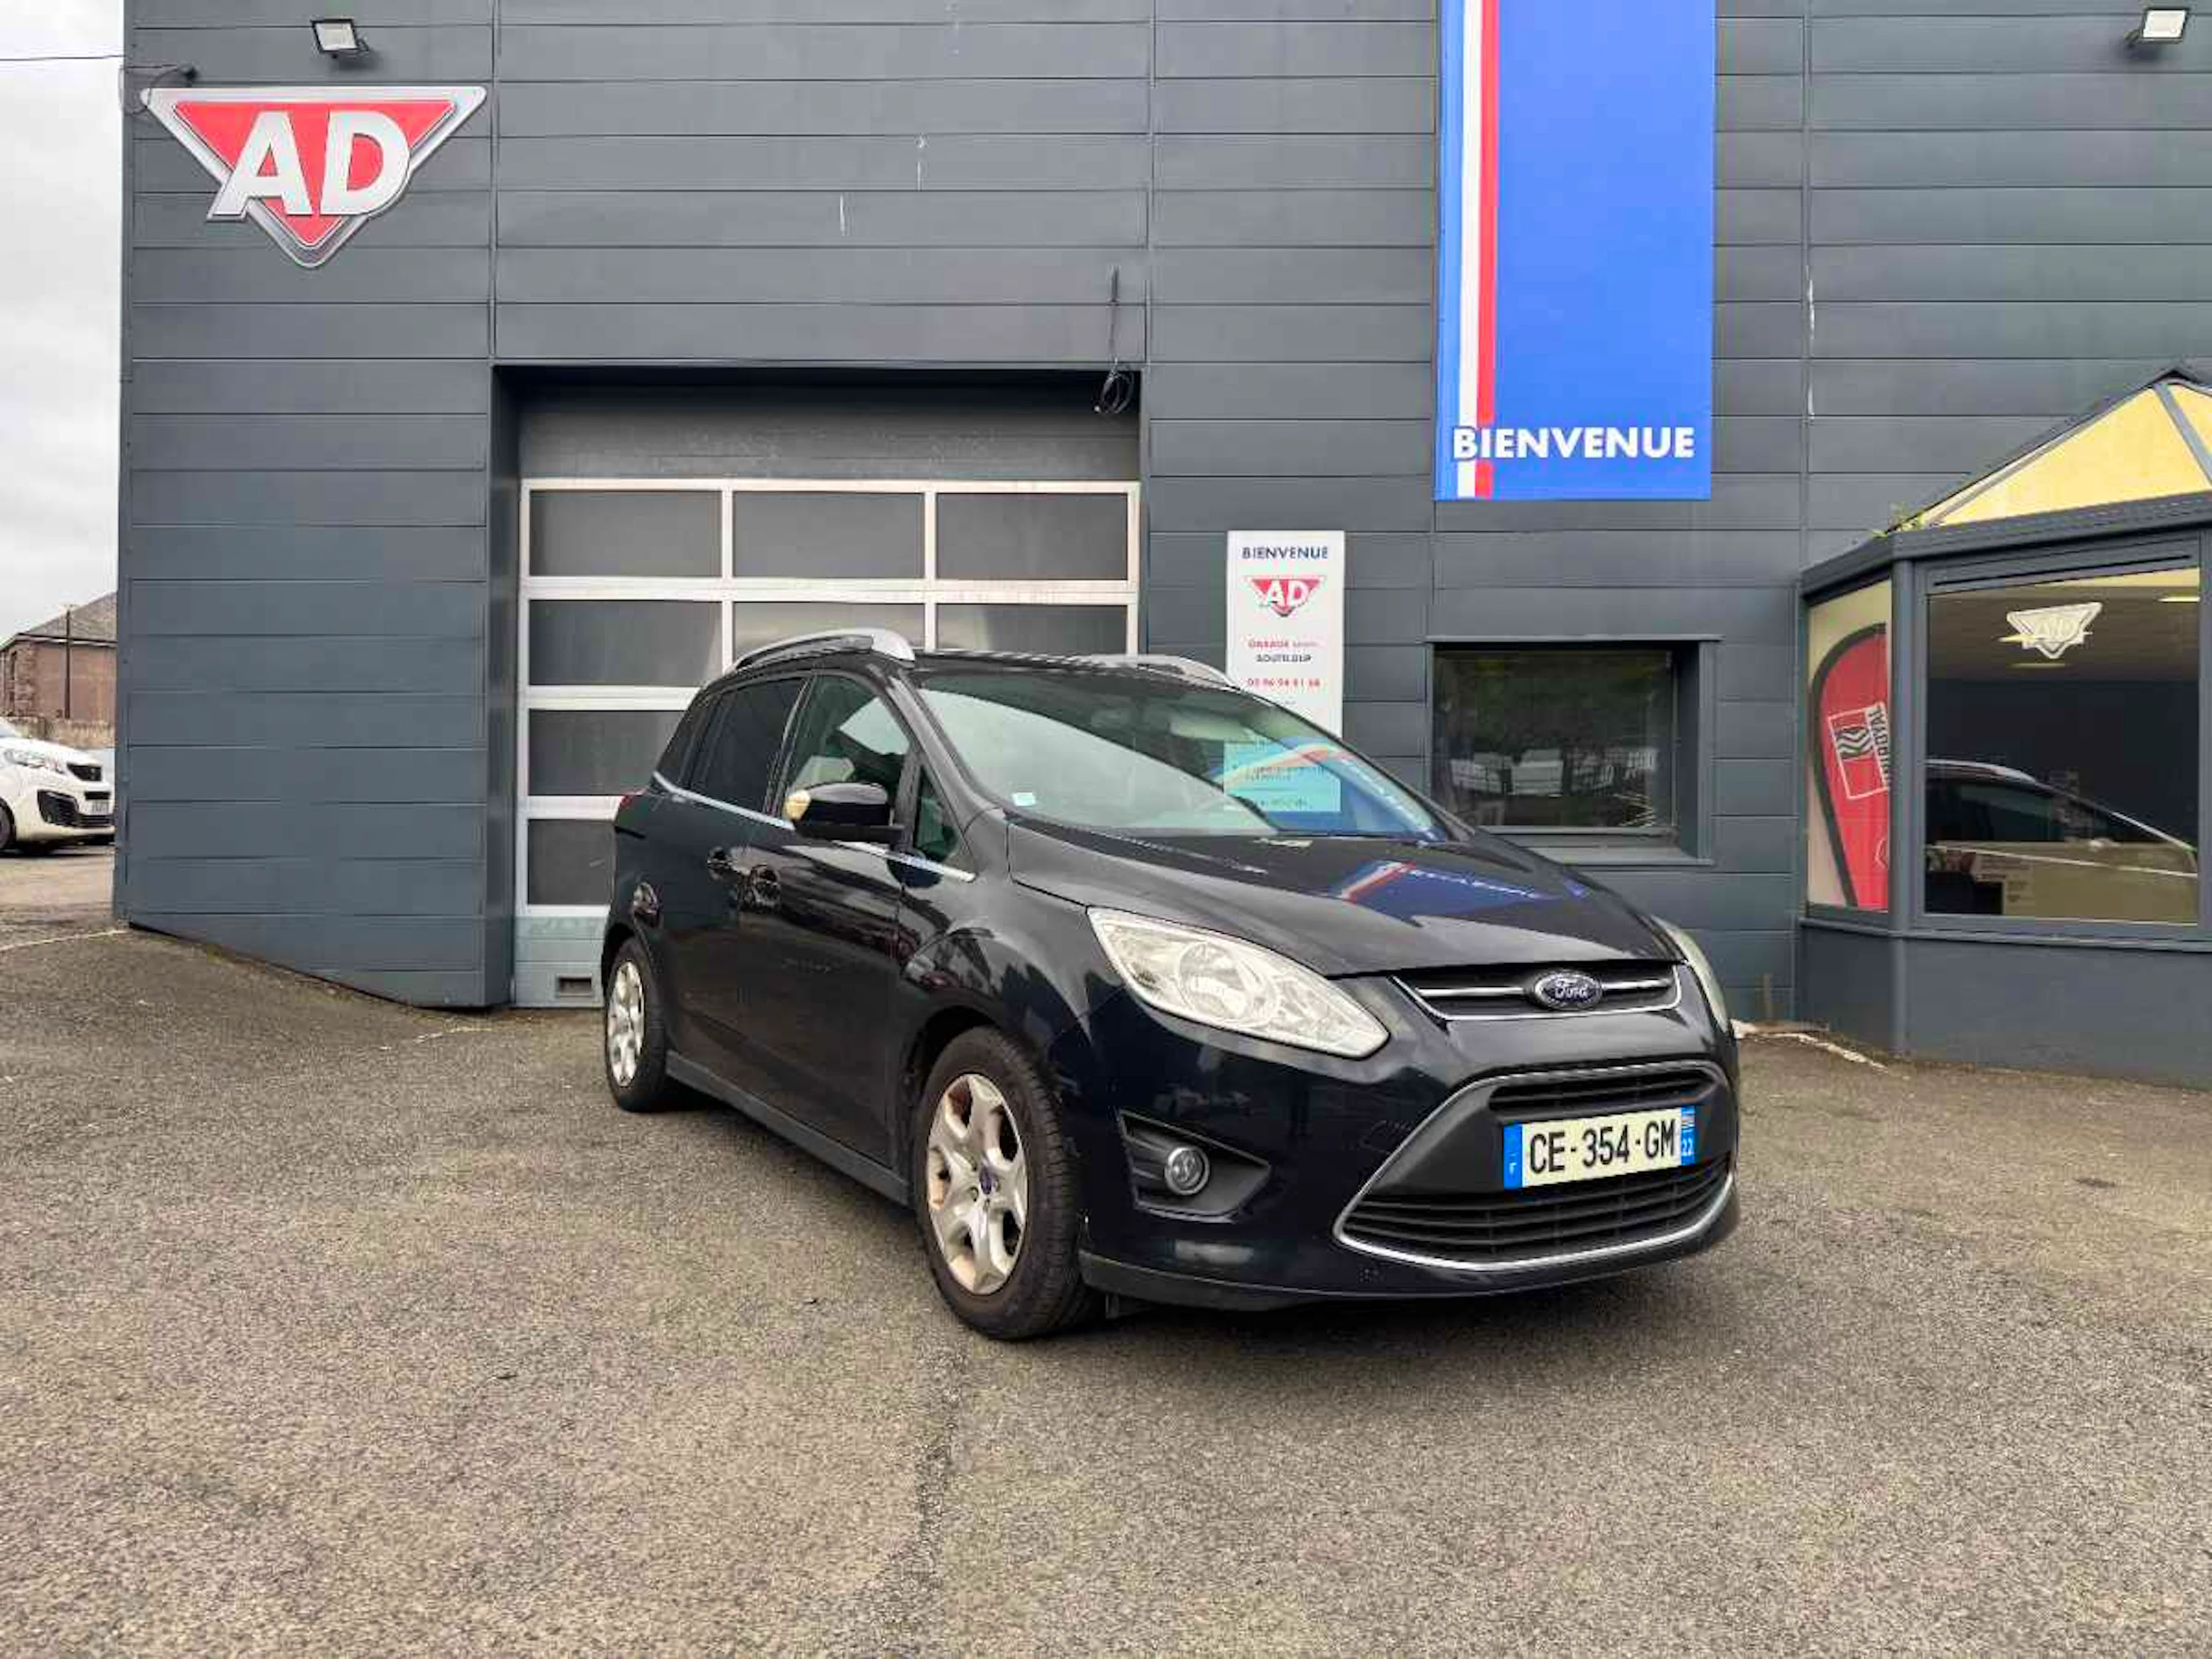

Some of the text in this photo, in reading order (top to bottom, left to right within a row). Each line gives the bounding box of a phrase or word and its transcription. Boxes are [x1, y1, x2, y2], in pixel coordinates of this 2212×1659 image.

[207, 110, 411, 221] AD
[1453, 426, 1695, 459] BIENVENUE
[1241, 546, 1328, 559] BIENVENUE
[1260, 579, 1310, 607] AD
[1554, 978, 1590, 998] Ford
[1530, 1119, 1676, 1174] CE-354-GM
